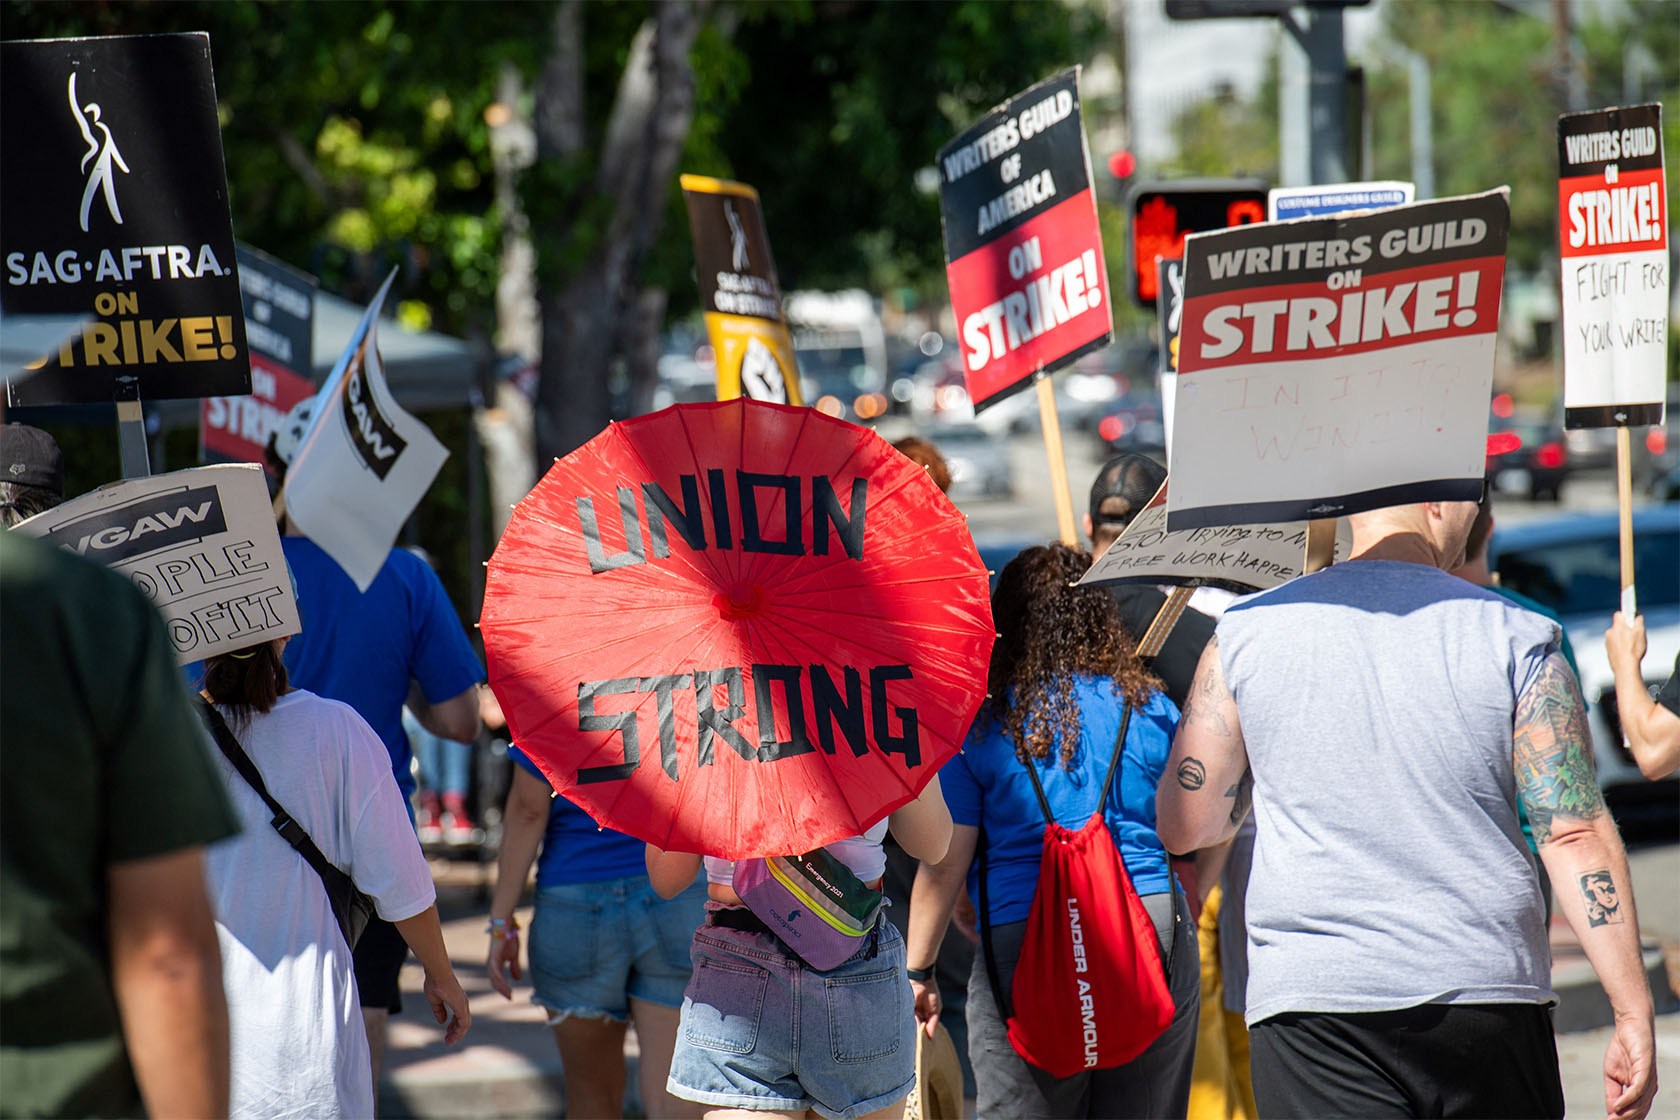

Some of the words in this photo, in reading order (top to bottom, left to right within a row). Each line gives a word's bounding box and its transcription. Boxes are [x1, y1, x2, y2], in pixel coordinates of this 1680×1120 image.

[944, 121, 1020, 183] WRITERS
[1019, 89, 1073, 141] GUILD
[1566, 131, 1620, 164] WRITERS
[1621, 126, 1656, 157] GUILD
[1001, 153, 1021, 184] OF
[1605, 164, 1618, 184] ON
[978, 169, 1056, 235] AMERICA
[1569, 182, 1661, 248] STRIKE!
[1009, 237, 1043, 280] ON
[1207, 236, 1371, 280] WRITERS
[1379, 218, 1487, 258] GUILD
[1327, 269, 1361, 290] ON
[94, 291, 139, 316] ON
[963, 250, 1102, 371] STRIKE!
[1577, 261, 1630, 302] FIGHT
[1643, 263, 1664, 290] FOR
[1200, 270, 1480, 359] STRIKE!
[576, 469, 867, 573] UNION
[131, 540, 269, 600] OPLE
[1100, 555, 1165, 573] FREE
[1172, 550, 1233, 567] WORK
[1232, 551, 1303, 580] HAPPE
[168, 586, 283, 652] OFIT
[577, 664, 922, 785] STRONG
[1067, 898, 1088, 973] UNDER
[1077, 979, 1098, 1068] ARMOUR
